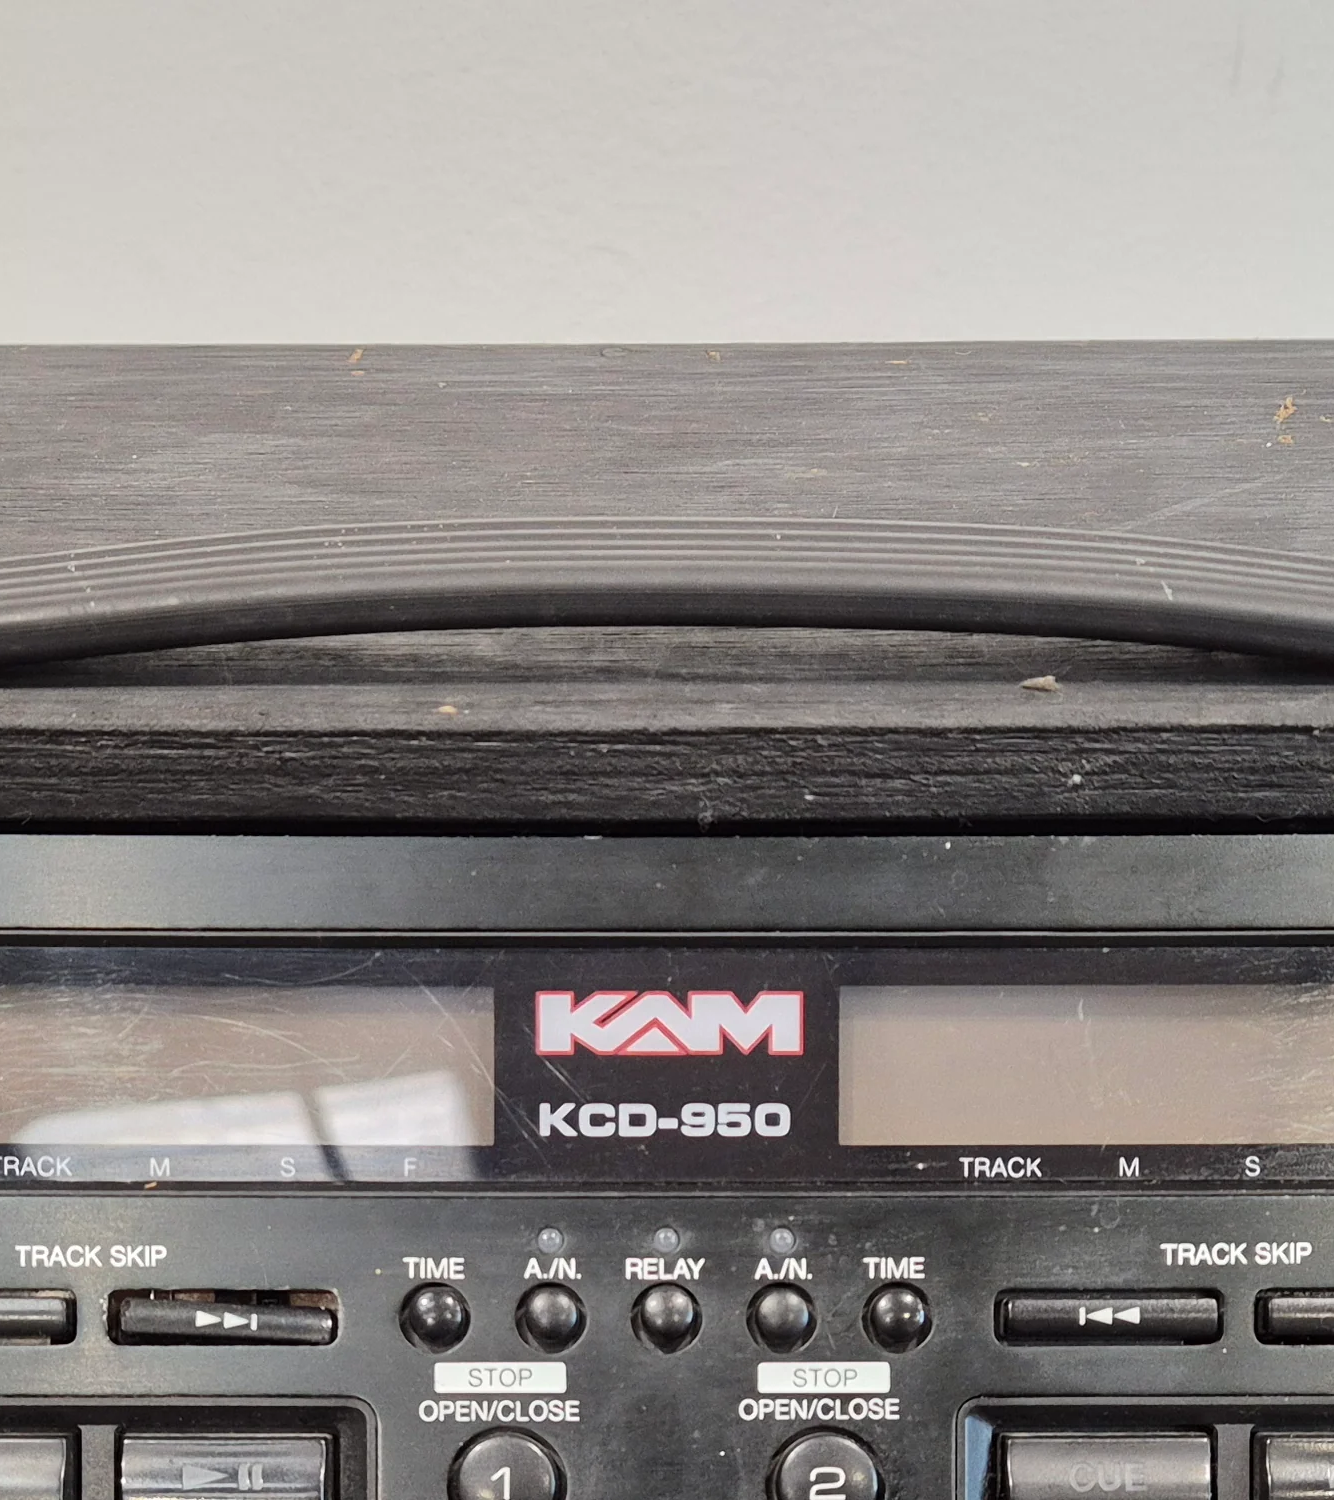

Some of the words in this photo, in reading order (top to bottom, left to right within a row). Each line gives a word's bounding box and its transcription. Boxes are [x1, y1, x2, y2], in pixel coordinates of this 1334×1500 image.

[535, 991, 803, 1056] KAM
[539, 1102, 791, 1138] KCD-950
[149, 1157, 171, 1177] M
[280, 1156, 296, 1178] S
[403, 1157, 417, 1177] F
[958, 1156, 1042, 1179] TRACK
[1119, 1156, 1140, 1178] M
[1245, 1155, 1261, 1177] S
[14, 1244, 103, 1268] TRACK
[109, 1244, 168, 1268] SKIP
[1159, 1242, 1248, 1266] TRACK
[1254, 1241, 1313, 1266] SKIP
[402, 1256, 466, 1280] TIME
[625, 1257, 706, 1281] RELAY
[862, 1256, 926, 1280] TIME
[468, 1367, 533, 1388] STOP
[792, 1367, 858, 1388] STOP
[418, 1399, 581, 1423] OPEN/CLOSE
[738, 1397, 900, 1422] OPEN/CLOSE
[490, 1466, 511, 1500] 1
[1069, 1462, 1146, 1492] CUE
